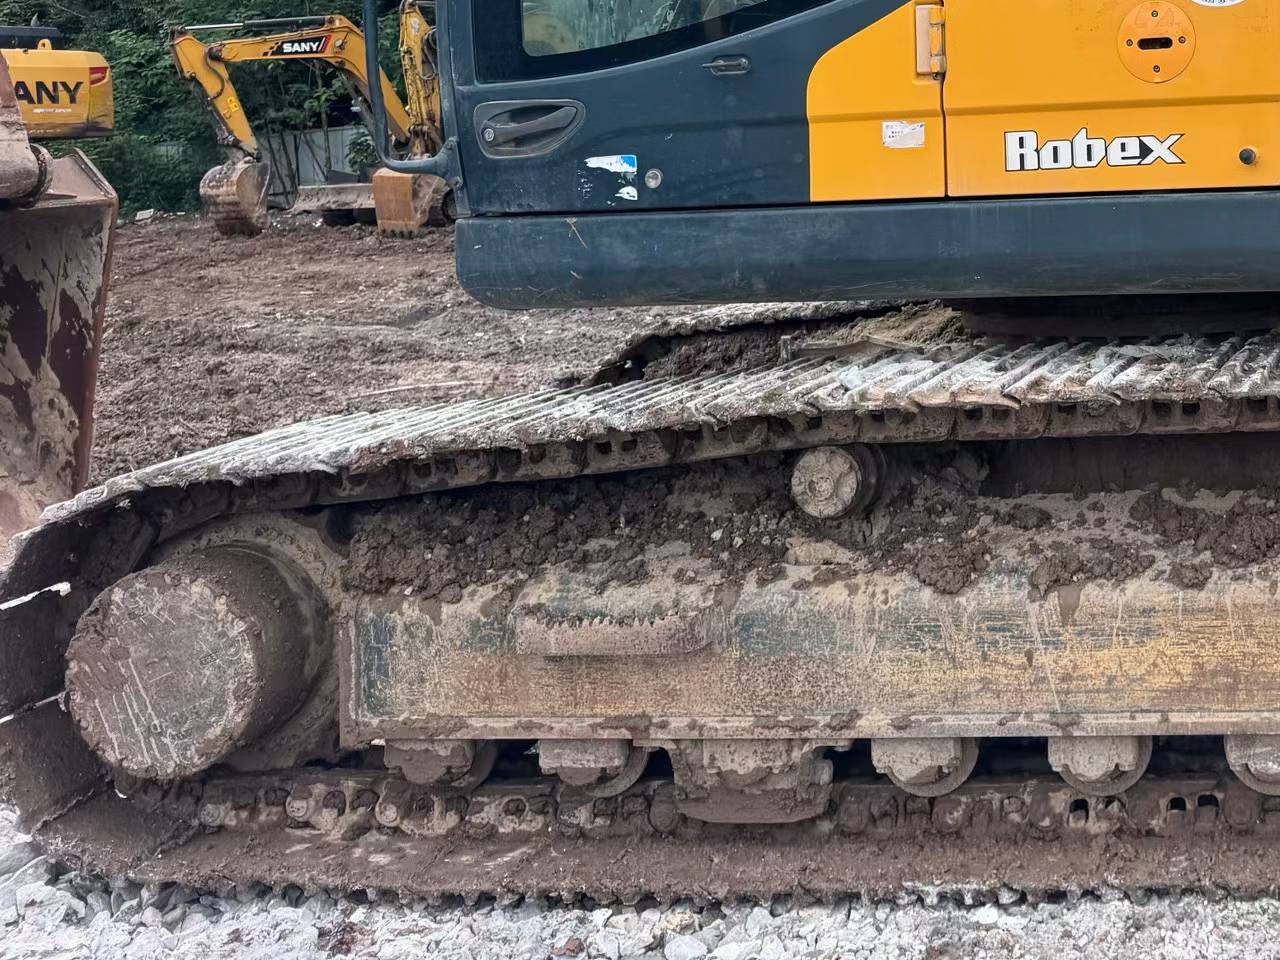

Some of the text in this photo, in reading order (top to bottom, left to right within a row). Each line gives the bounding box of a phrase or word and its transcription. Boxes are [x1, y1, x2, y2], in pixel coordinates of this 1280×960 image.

[282, 41, 319, 53] SANY
[14, 80, 83, 104] ANY
[1003, 127, 1186, 172] Robex
